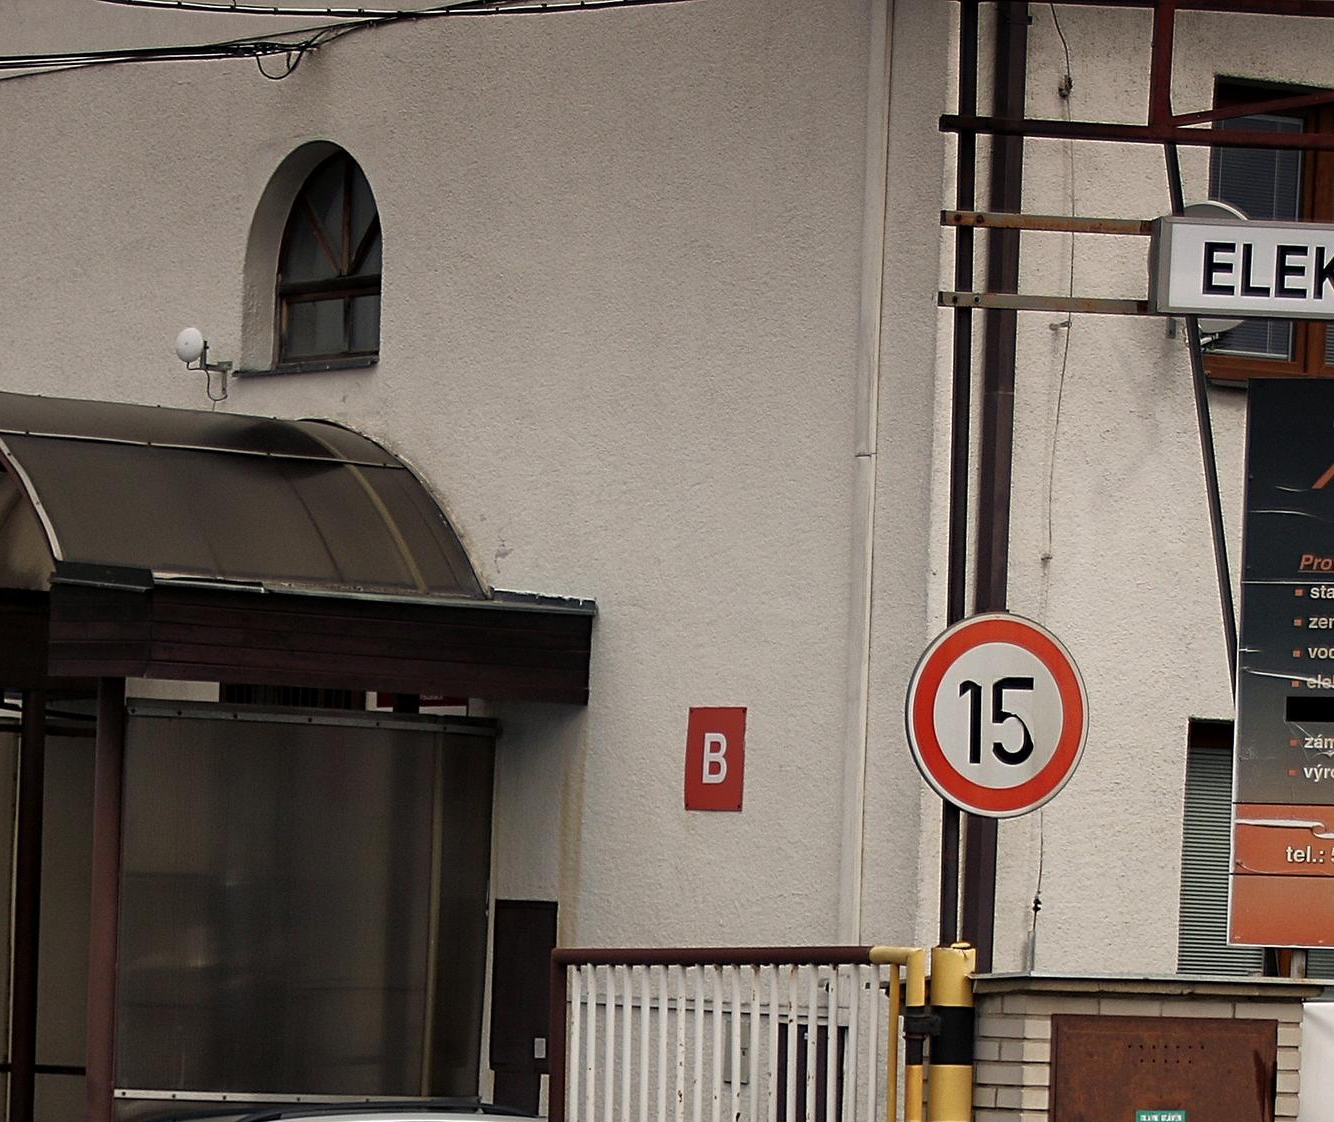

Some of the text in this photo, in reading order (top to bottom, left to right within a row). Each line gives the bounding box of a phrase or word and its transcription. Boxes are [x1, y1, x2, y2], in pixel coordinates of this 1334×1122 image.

[958, 677, 1036, 765] 15
[702, 732, 728, 785] B
[1286, 845, 1324, 863] tel.:
